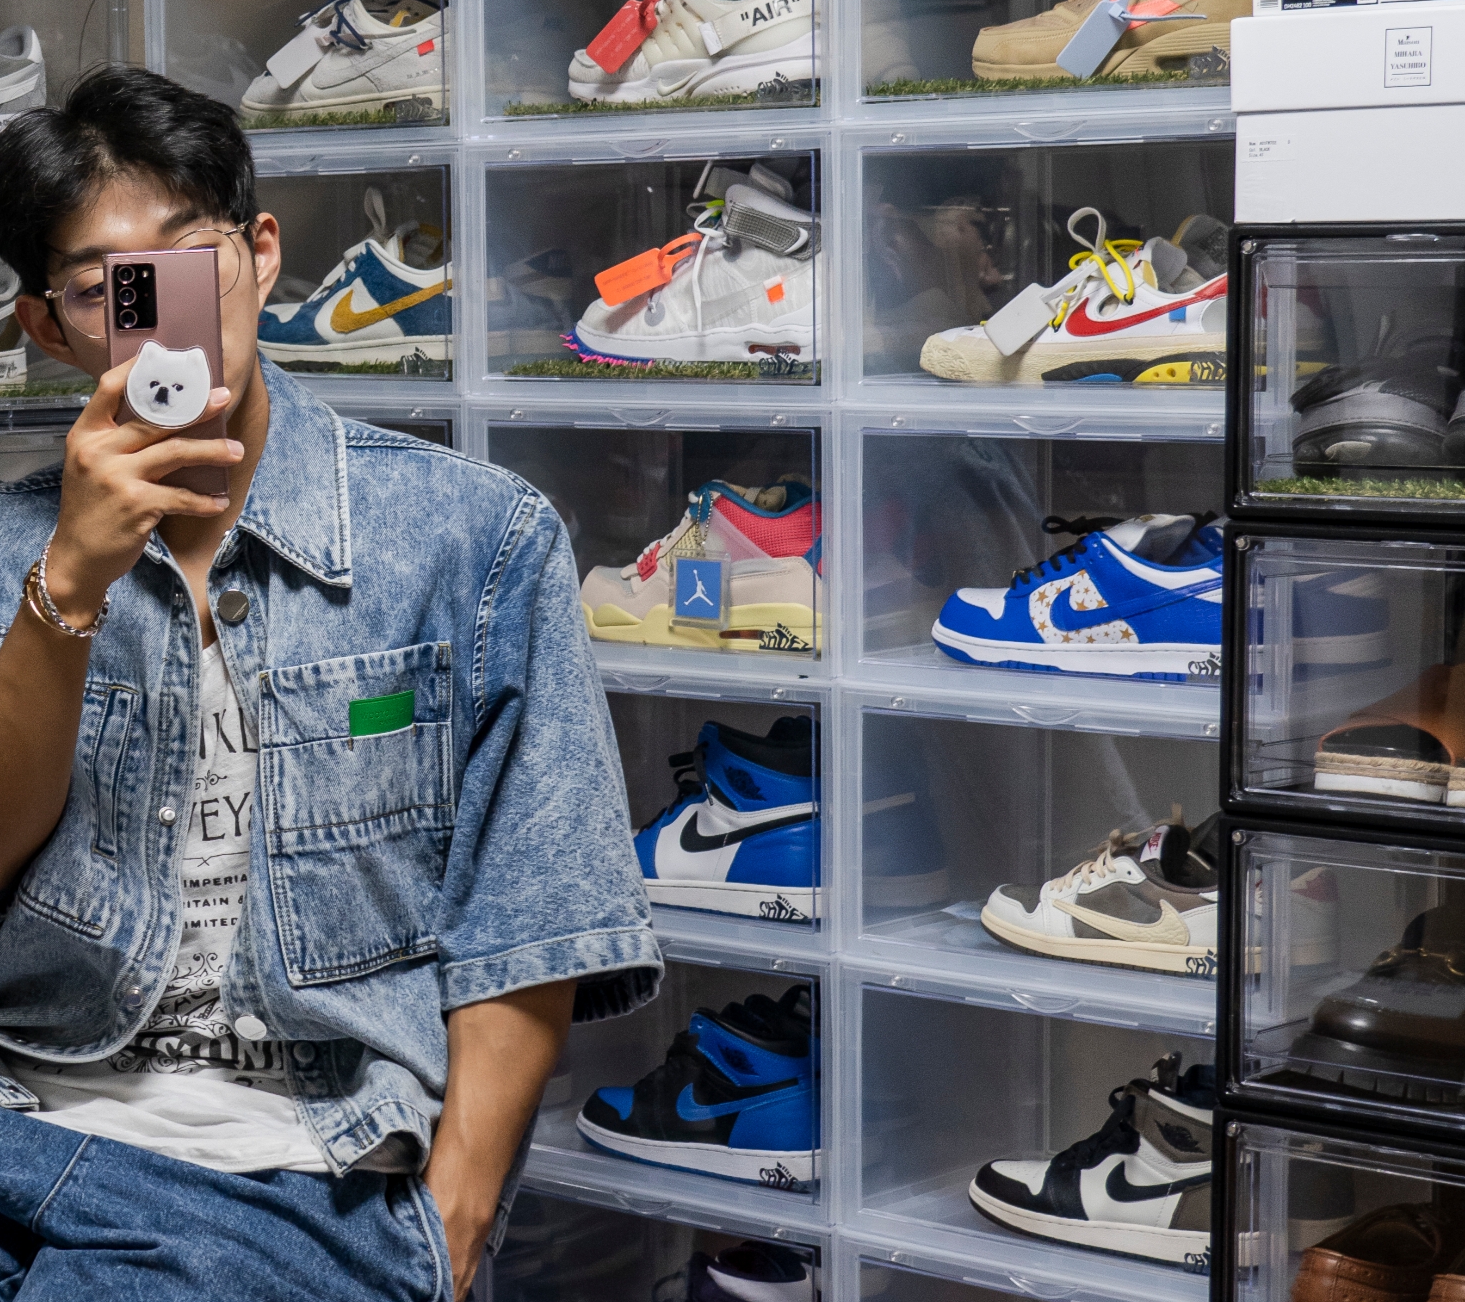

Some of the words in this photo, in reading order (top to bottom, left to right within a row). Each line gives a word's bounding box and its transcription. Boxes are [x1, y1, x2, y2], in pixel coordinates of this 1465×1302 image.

[183, 873, 248, 888] IMPERIA
[184, 897, 228, 909] ITAIN
[184, 917, 238, 930] IMITED
